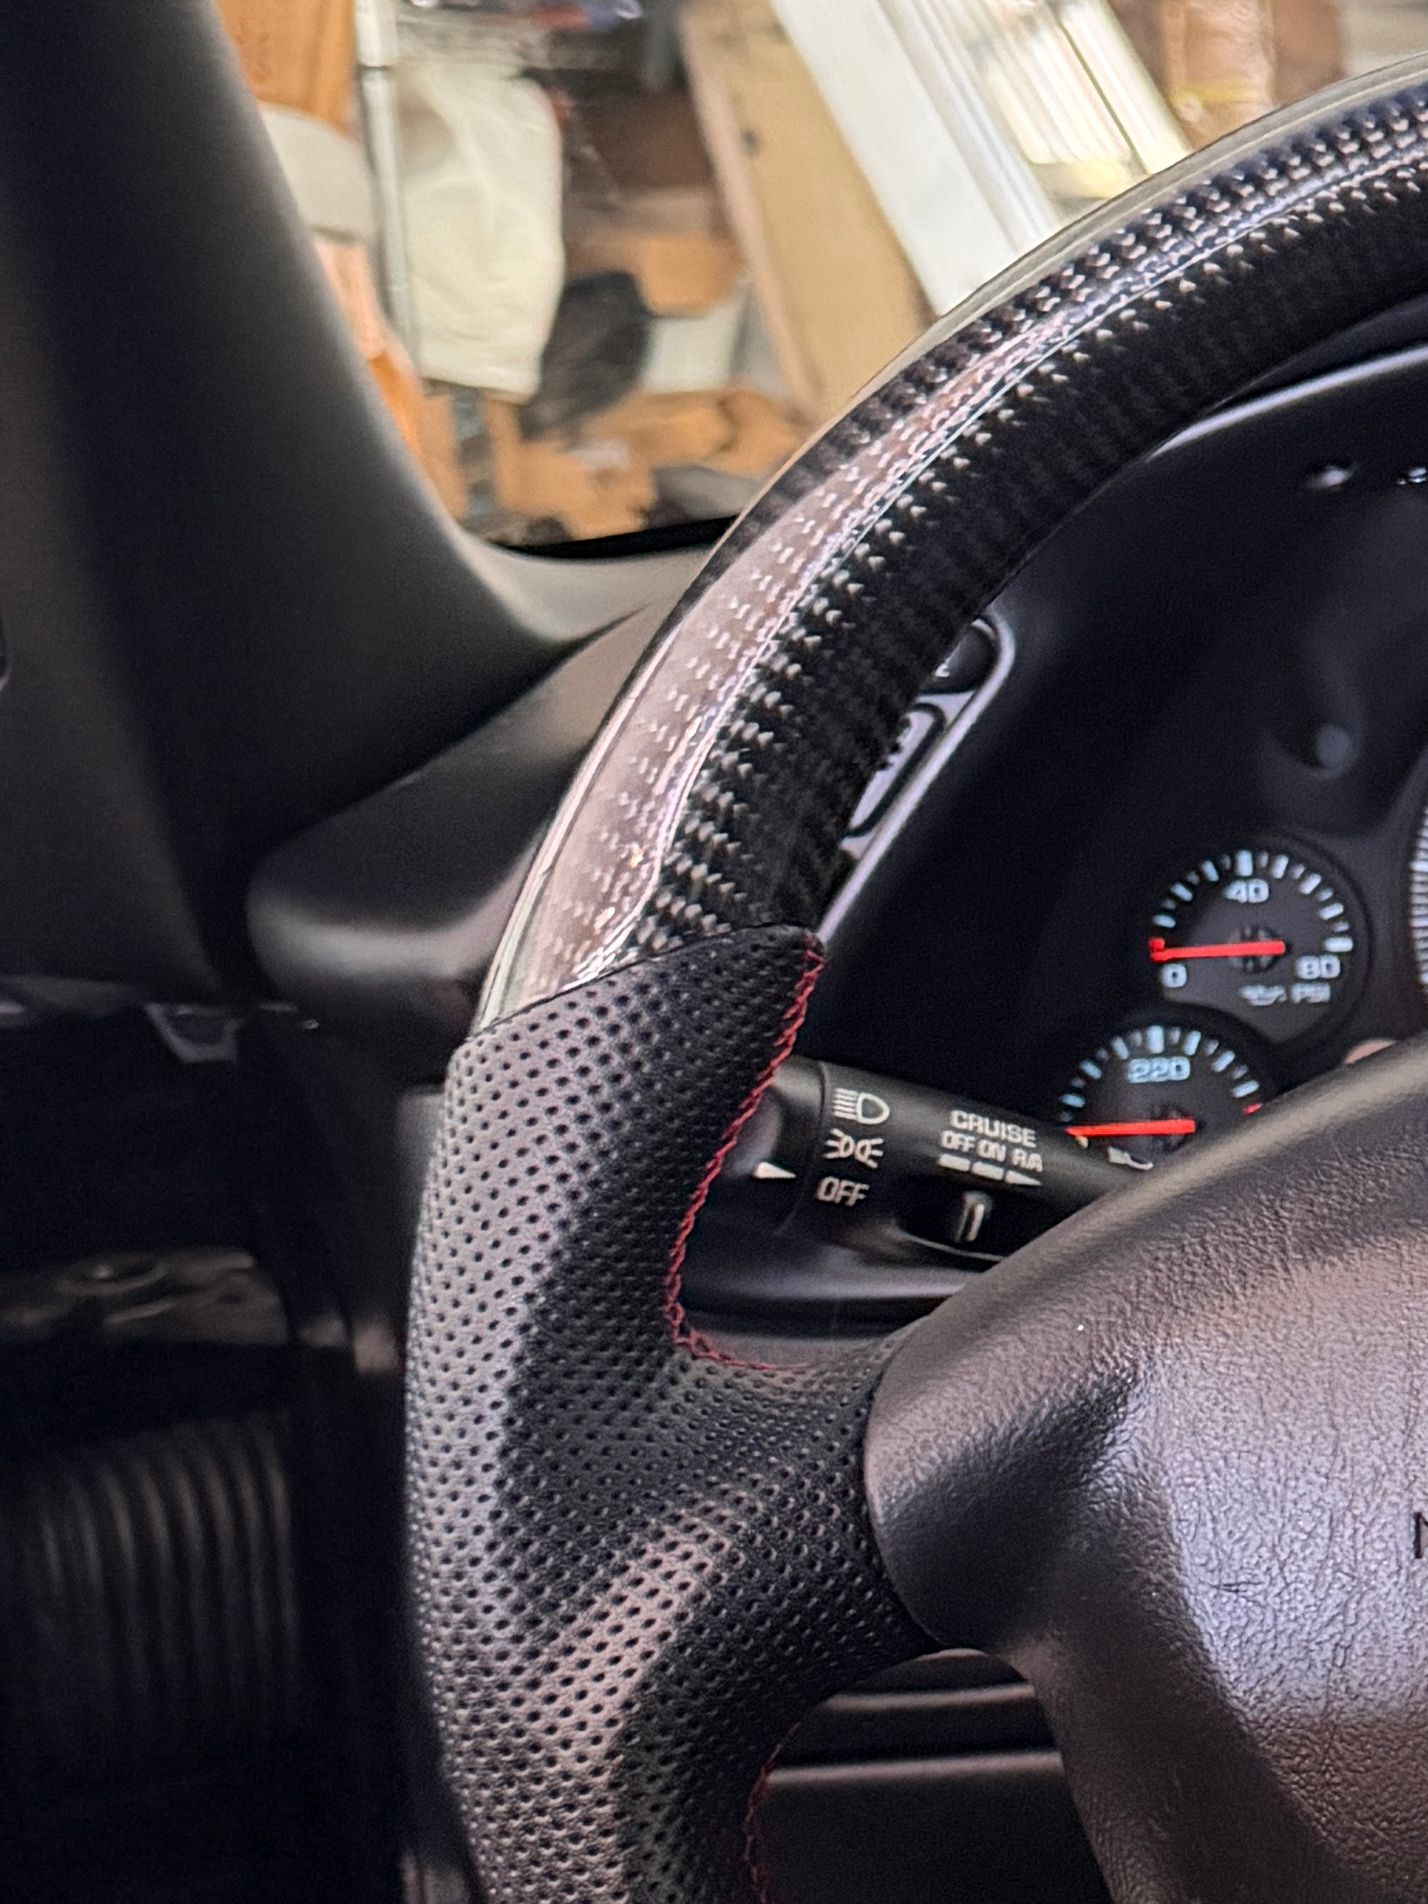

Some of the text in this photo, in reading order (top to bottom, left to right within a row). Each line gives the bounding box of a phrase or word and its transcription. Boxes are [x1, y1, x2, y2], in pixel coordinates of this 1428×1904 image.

[1224, 879, 1269, 903] 40
[1161, 963, 1188, 988] 0
[1297, 955, 1341, 979] 80
[1127, 1056, 1191, 1084] 220
[950, 1109, 1037, 1148] CRUISE
[940, 1130, 1043, 1172] OFF ON RA
[816, 1176, 870, 1207] OFF
